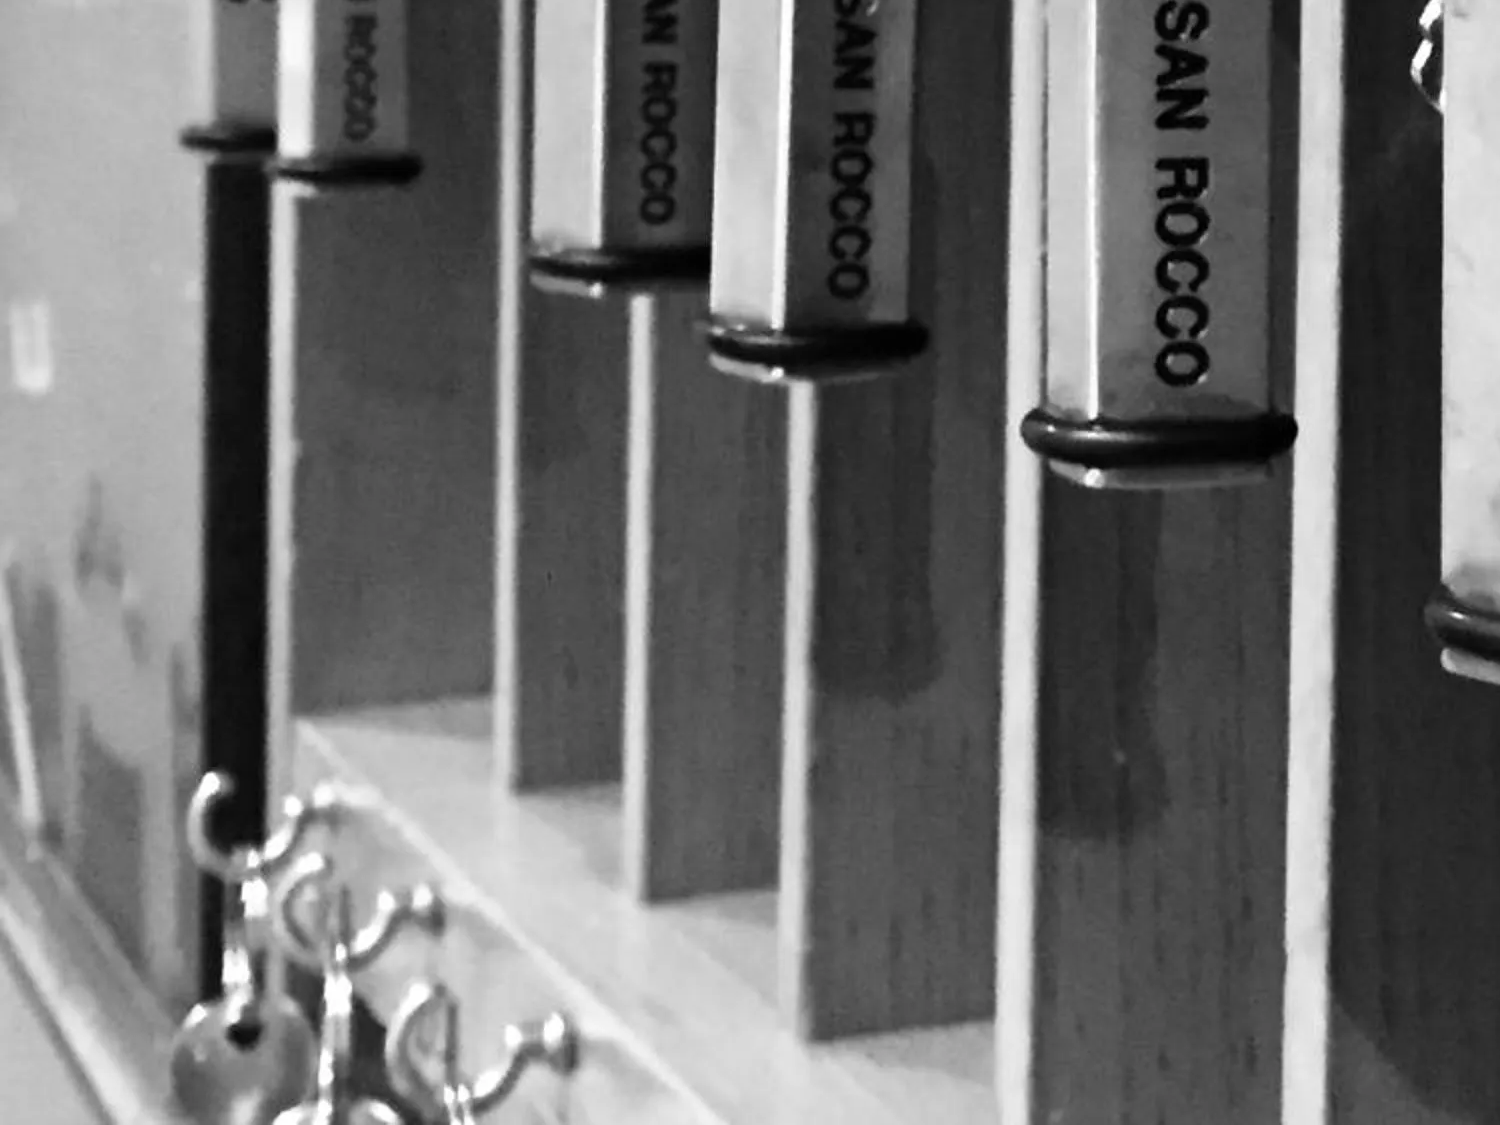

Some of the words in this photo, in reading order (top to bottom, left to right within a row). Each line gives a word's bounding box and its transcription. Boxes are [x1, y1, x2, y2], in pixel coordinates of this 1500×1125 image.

[343, 14, 378, 142] ROCCO
[639, 61, 679, 226] ROCCO
[1153, 0, 1210, 132] SAN
[826, 111, 876, 303] ROCCO
[1153, 157, 1210, 389] ROCCO
